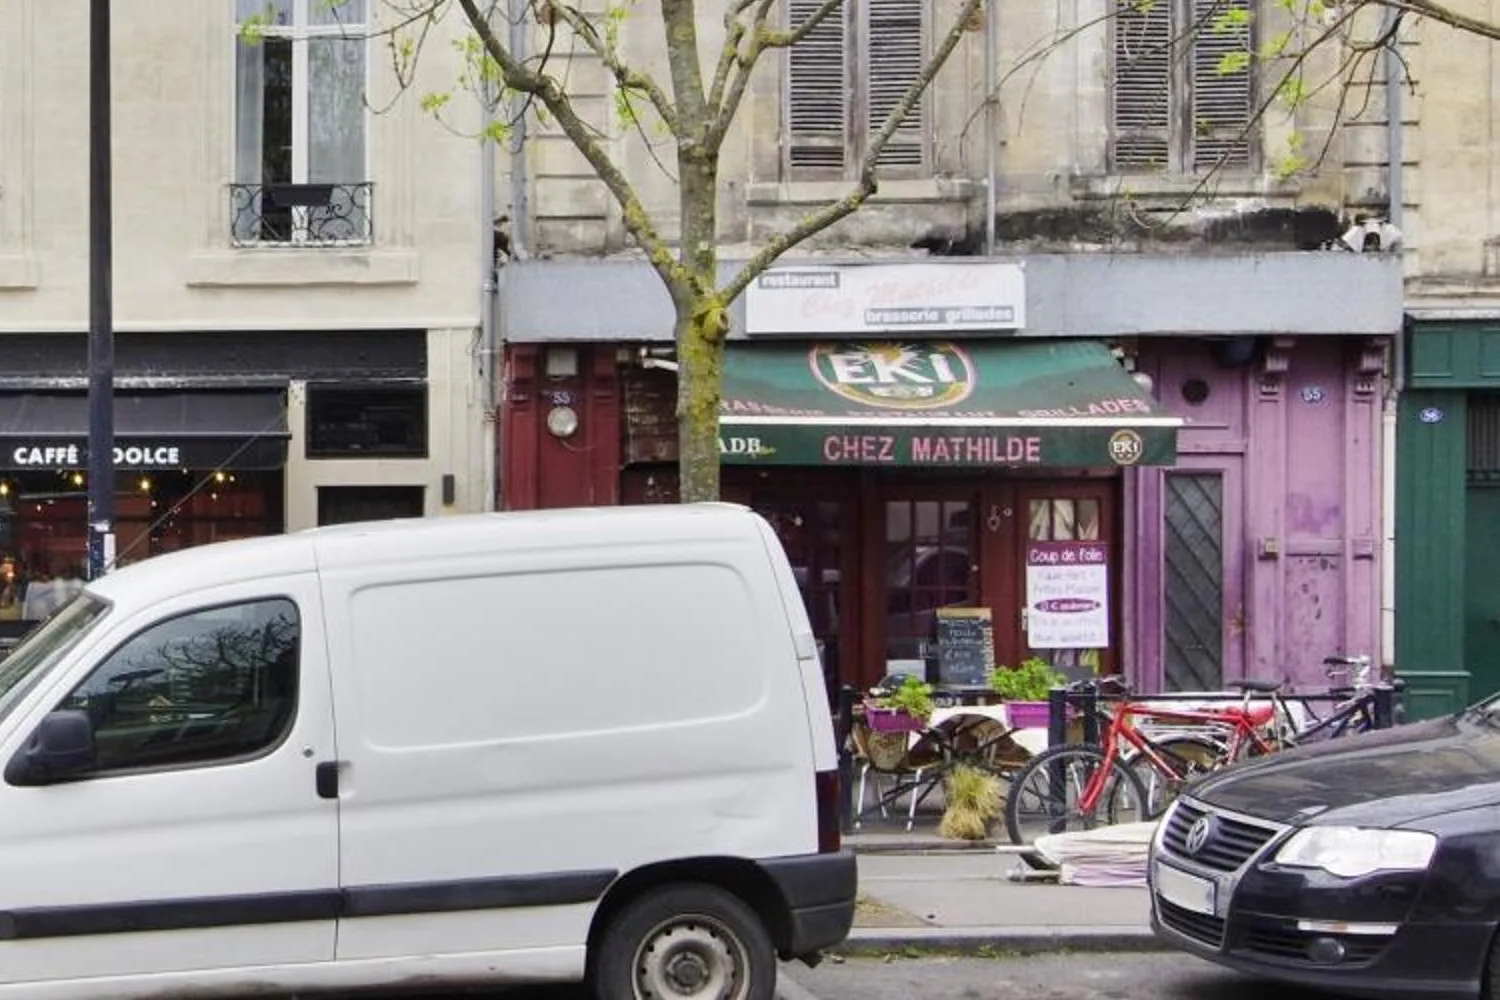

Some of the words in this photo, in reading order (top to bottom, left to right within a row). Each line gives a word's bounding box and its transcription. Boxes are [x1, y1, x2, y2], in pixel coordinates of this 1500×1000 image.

[761, 273, 837, 288] restaurant
[866, 308, 938, 323] brasserie
[946, 307, 1013, 323] grillades
[823, 435, 895, 461] CHEZ
[912, 435, 1041, 462] MATHILDE
[1029, 549, 1059, 562] Coup
[1061, 549, 1076, 561] de
